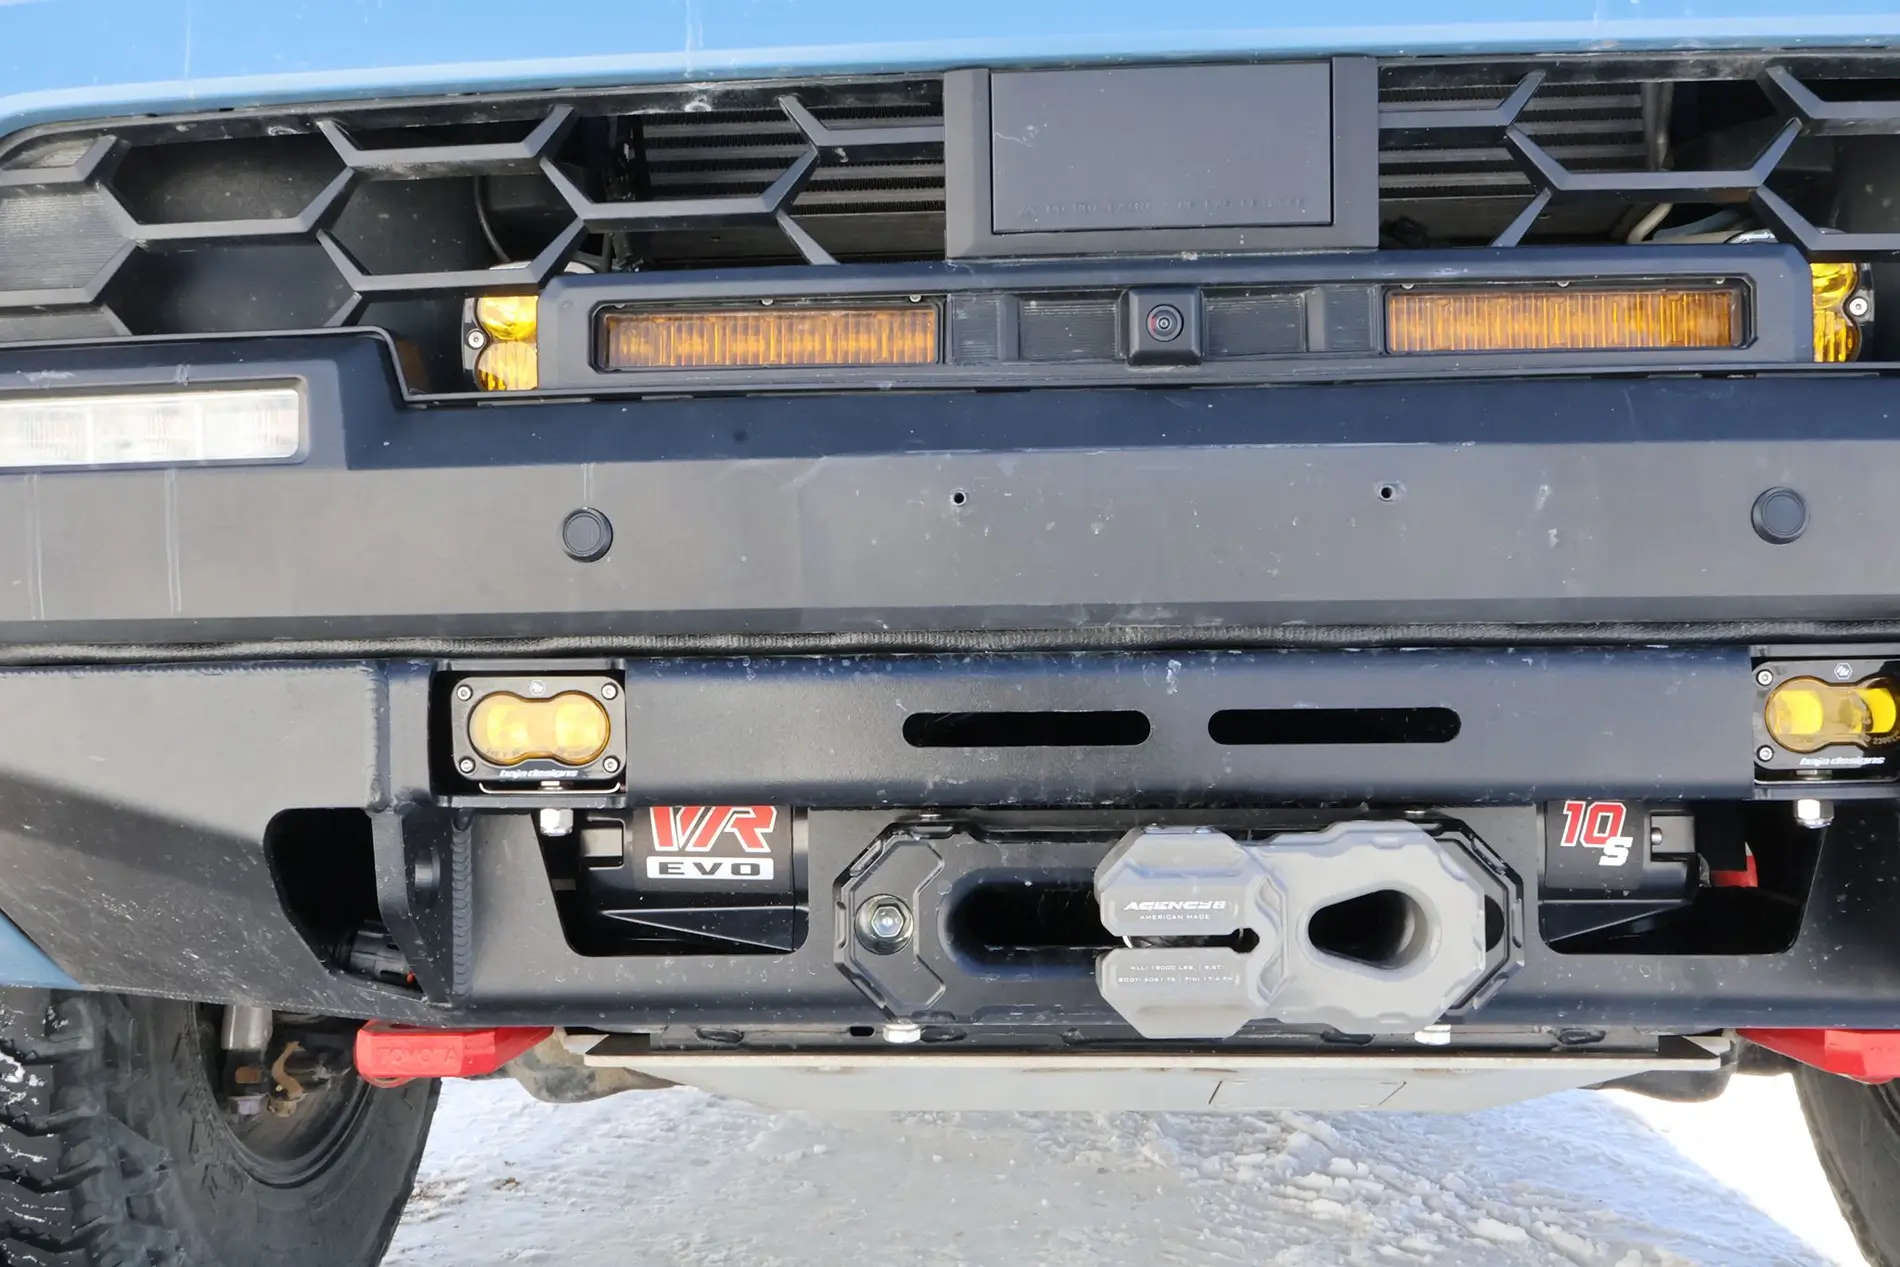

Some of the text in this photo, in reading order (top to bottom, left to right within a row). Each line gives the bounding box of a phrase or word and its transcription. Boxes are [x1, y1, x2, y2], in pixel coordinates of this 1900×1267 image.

[649, 805, 778, 853] VR
[658, 861, 761, 876] EVO
[1140, 913, 1183, 921] AMERICAN
